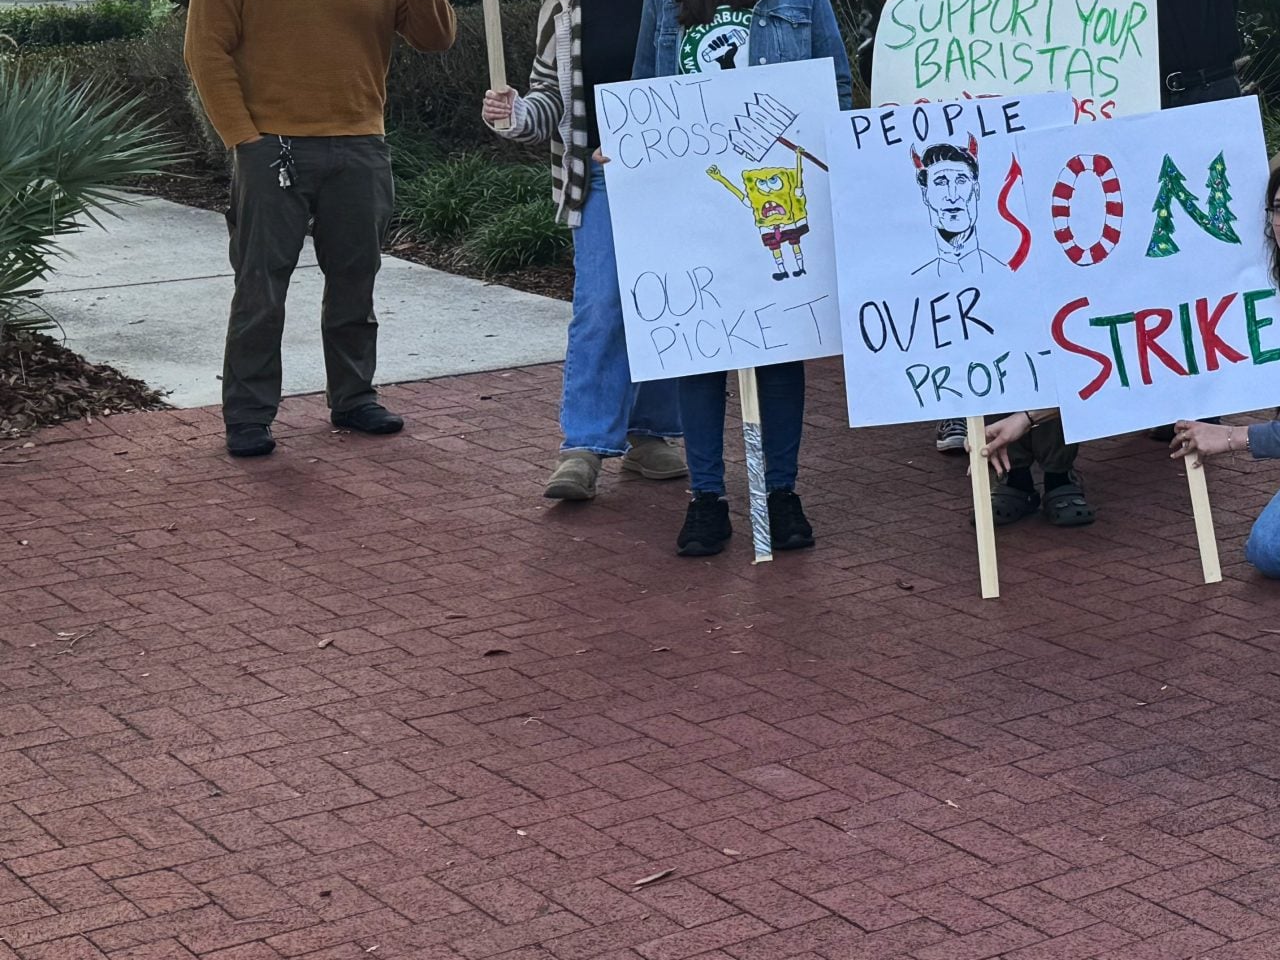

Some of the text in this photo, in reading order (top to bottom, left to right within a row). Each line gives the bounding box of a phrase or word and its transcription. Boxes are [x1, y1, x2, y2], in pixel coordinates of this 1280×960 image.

[914, 36, 1120, 98] BARISTAS
[599, 78, 713, 135] DON'T
[850, 100, 1027, 150] PEOPLE
[618, 122, 729, 169] CROSS
[630, 266, 722, 322] OUR
[858, 286, 995, 354] OVER
[905, 350, 1052, 408] PROFI
